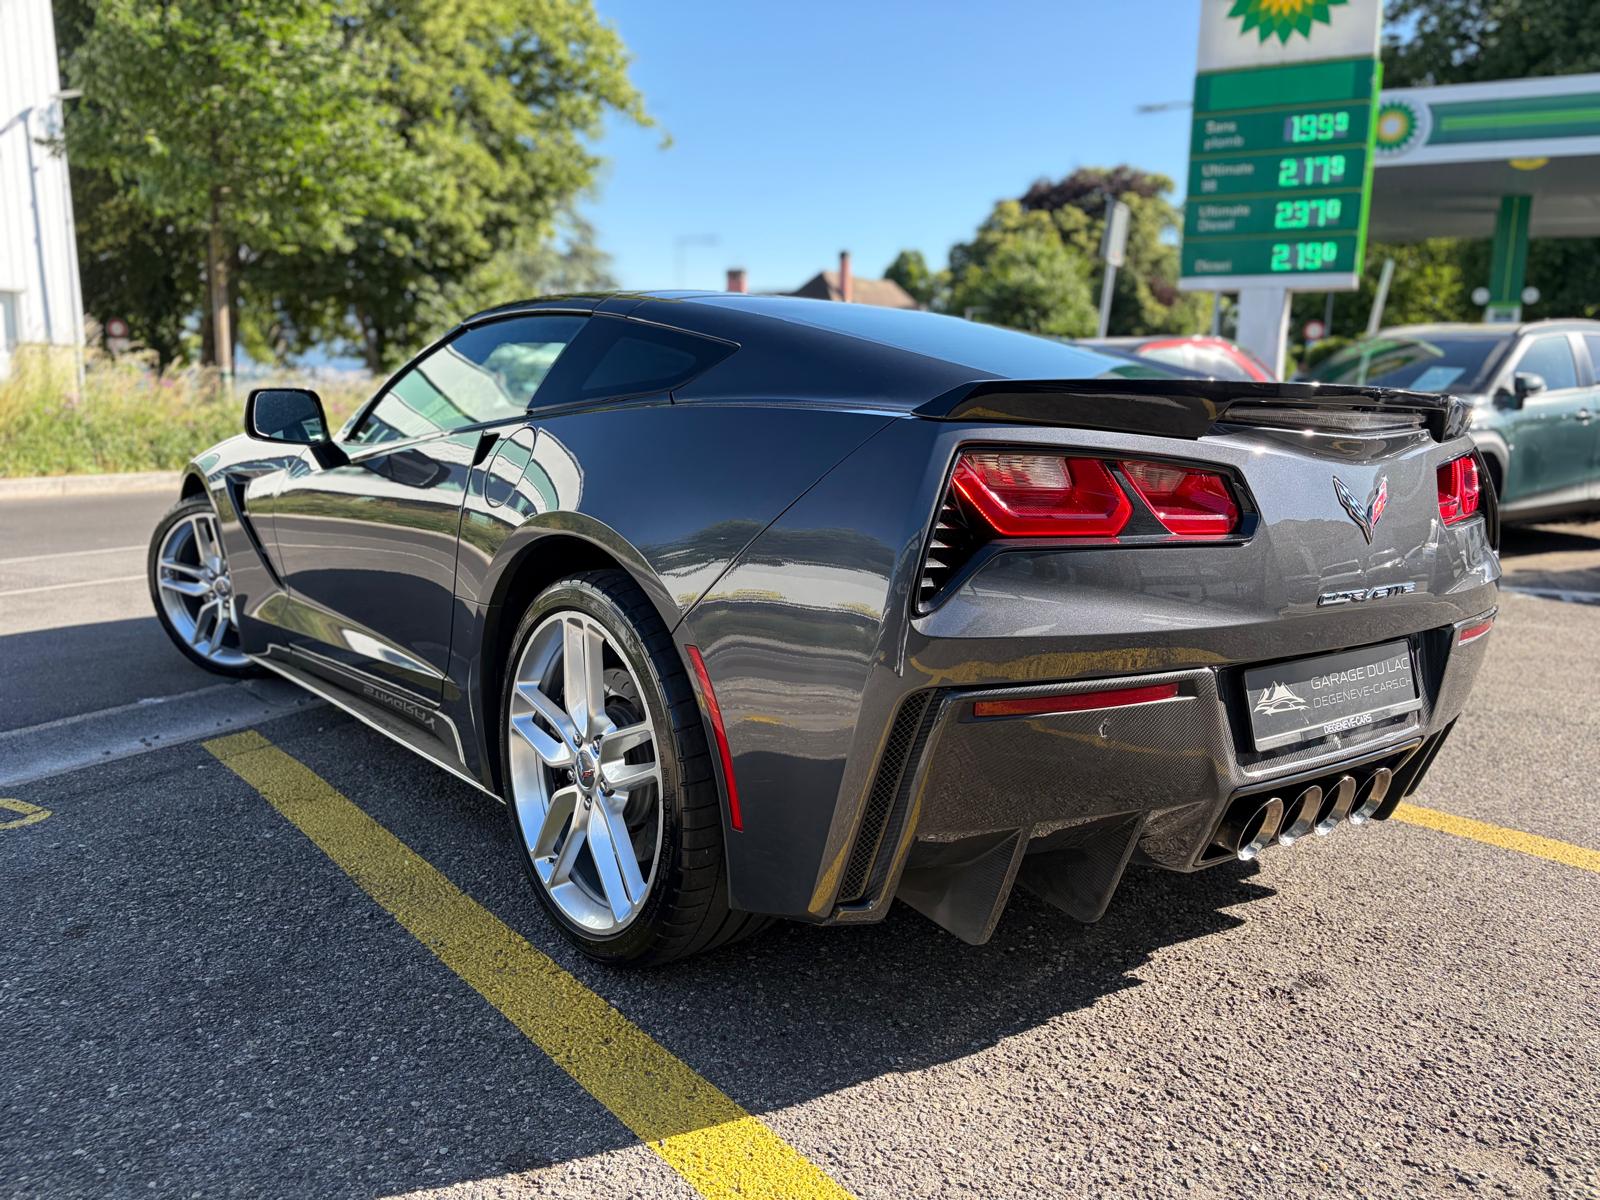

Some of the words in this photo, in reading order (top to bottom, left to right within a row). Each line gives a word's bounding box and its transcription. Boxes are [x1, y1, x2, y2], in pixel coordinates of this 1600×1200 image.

[1310, 667, 1365, 690] GARAGE
[1366, 662, 1385, 677] DU
[1386, 657, 1410, 674] LAC
[1313, 677, 1412, 709] DEGENEVE-CARS.CH
